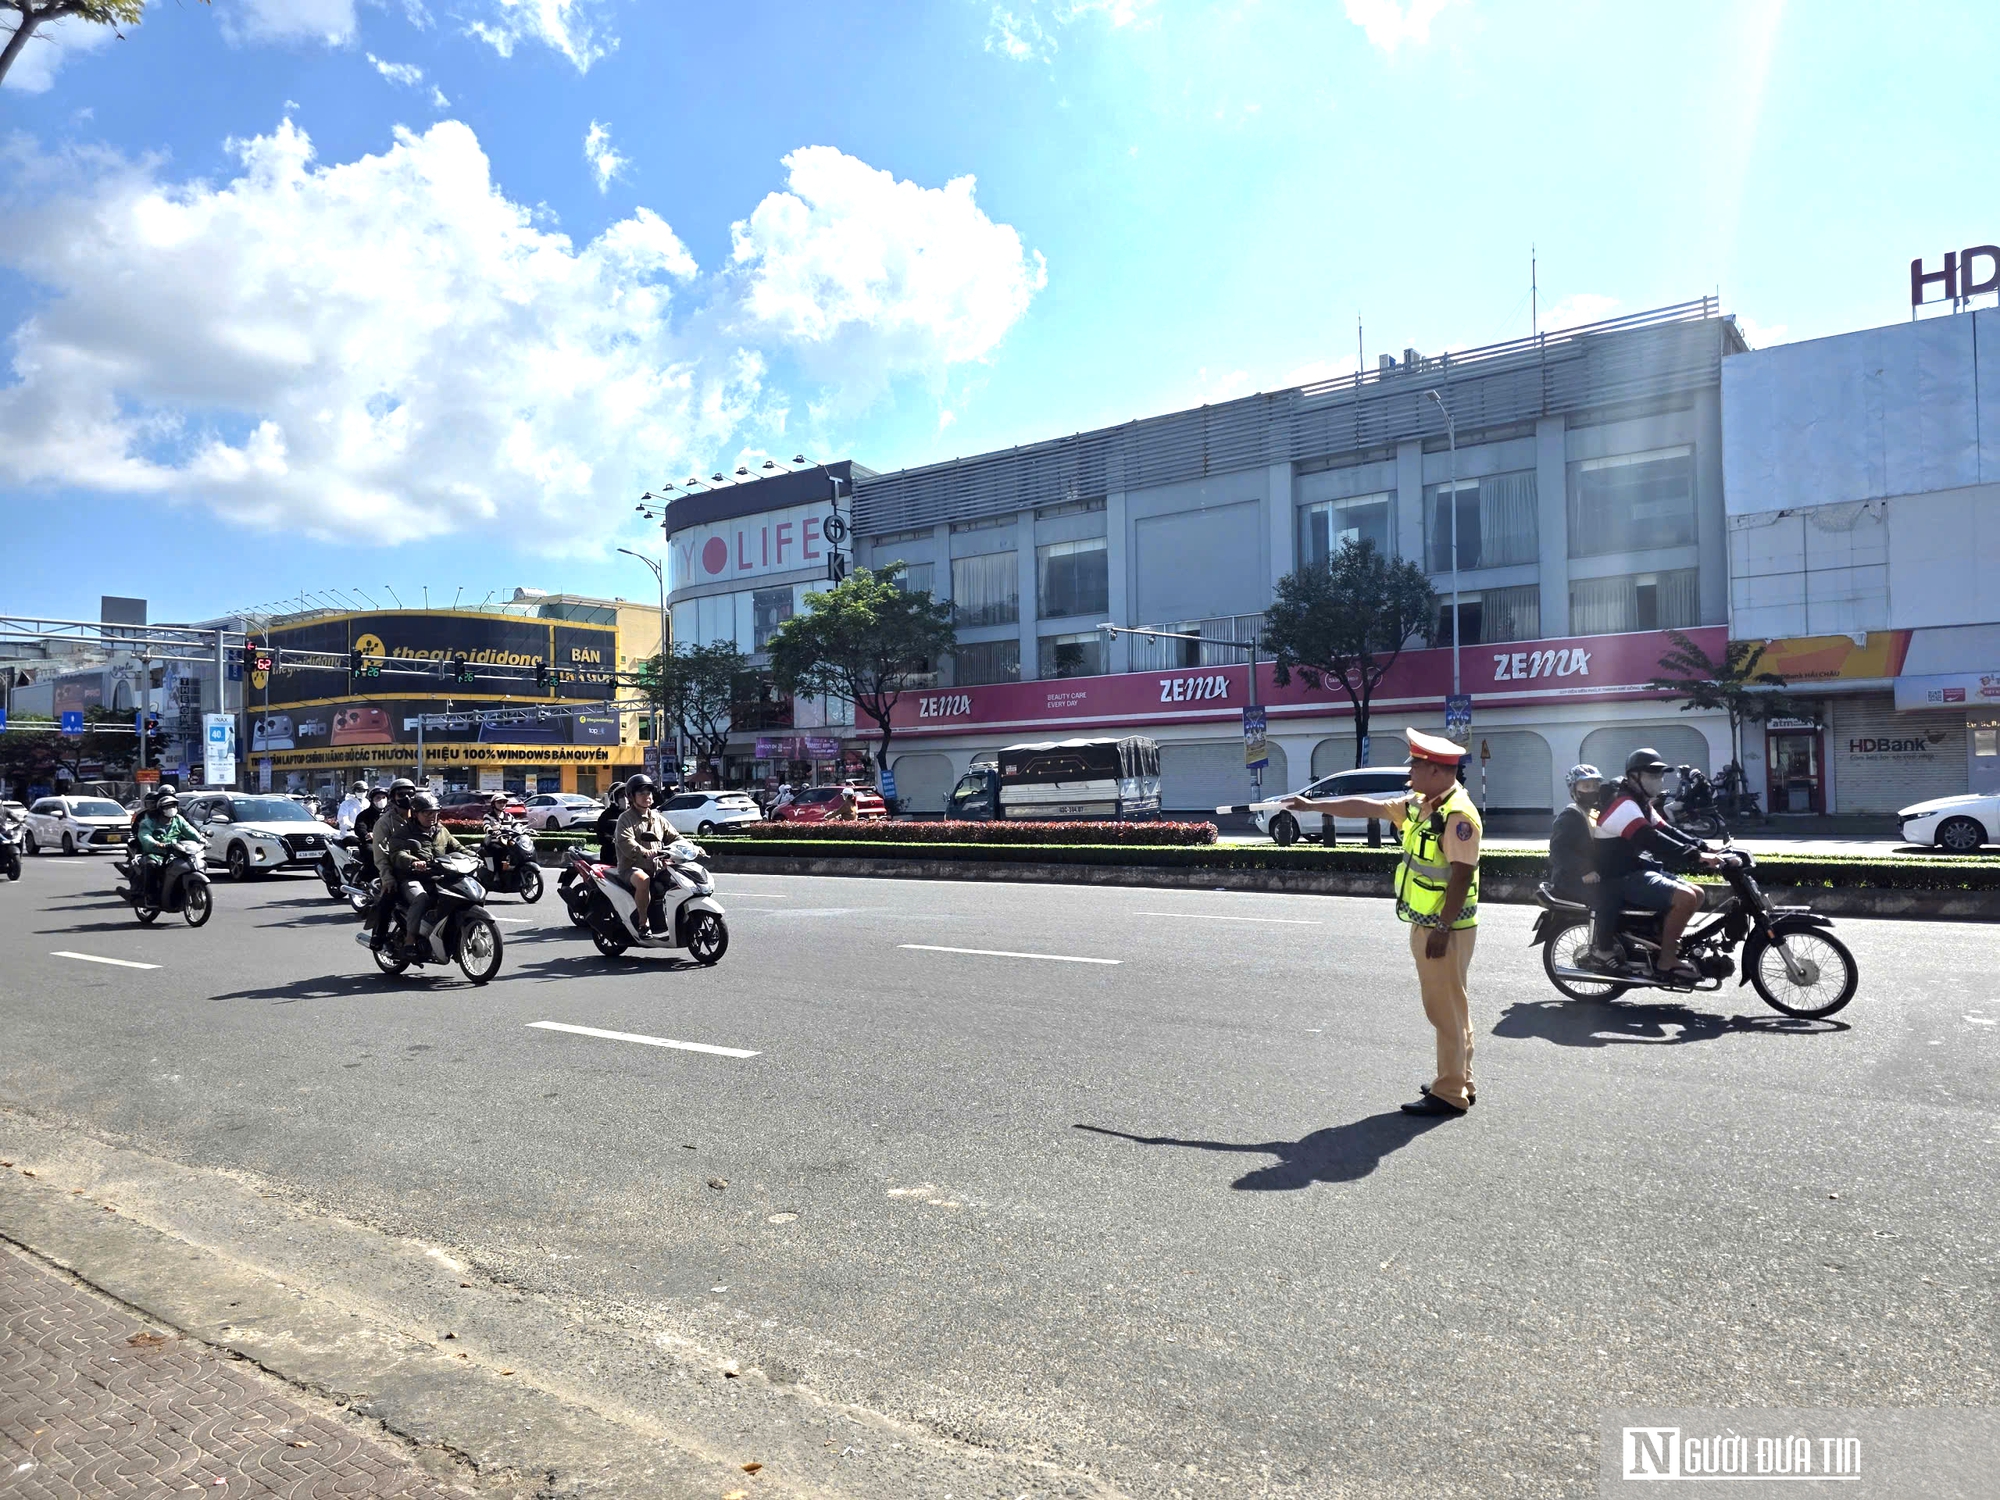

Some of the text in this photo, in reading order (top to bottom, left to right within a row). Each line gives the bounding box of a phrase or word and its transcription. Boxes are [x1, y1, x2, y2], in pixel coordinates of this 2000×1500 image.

[1911, 244, 2000, 306] HD
[572, 646, 600, 664] BÁN
[257, 659, 272, 671] 62
[1494, 647, 1592, 681] ZEMA
[367, 667, 380, 677] 26
[1160, 676, 1230, 702] ZEMA
[1047, 693, 1070, 701] BEAUTY
[919, 695, 972, 718] ZEMA
[299, 723, 327, 737] PRO
[1850, 737, 1926, 752] HDBank
[462, 749, 495, 760] 100%
[495, 749, 550, 760] WINDOWS
